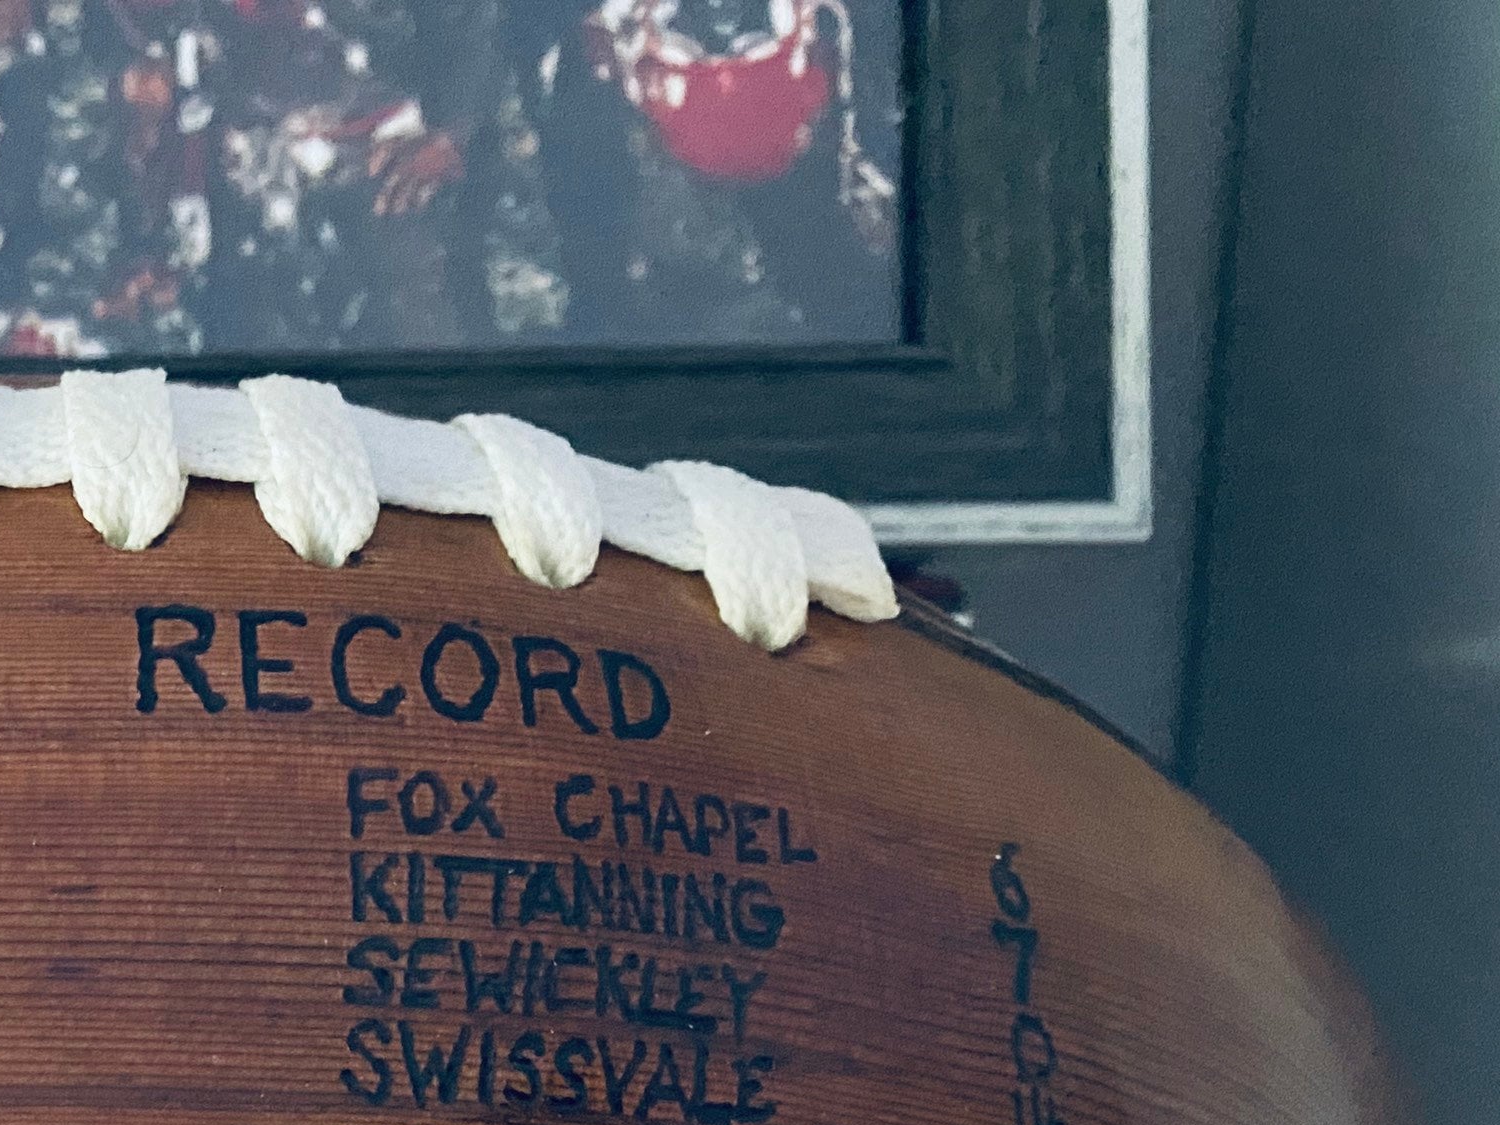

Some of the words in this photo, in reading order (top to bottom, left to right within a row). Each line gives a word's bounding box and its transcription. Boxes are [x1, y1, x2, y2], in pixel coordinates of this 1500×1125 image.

[134, 603, 672, 742] RECORD
[346, 767, 505, 840] FOX
[553, 773, 819, 865] CHAPEL
[348, 850, 787, 950] KITTANNING
[988, 918, 1040, 1006] 7
[343, 937, 769, 1044] SEWICKLEY
